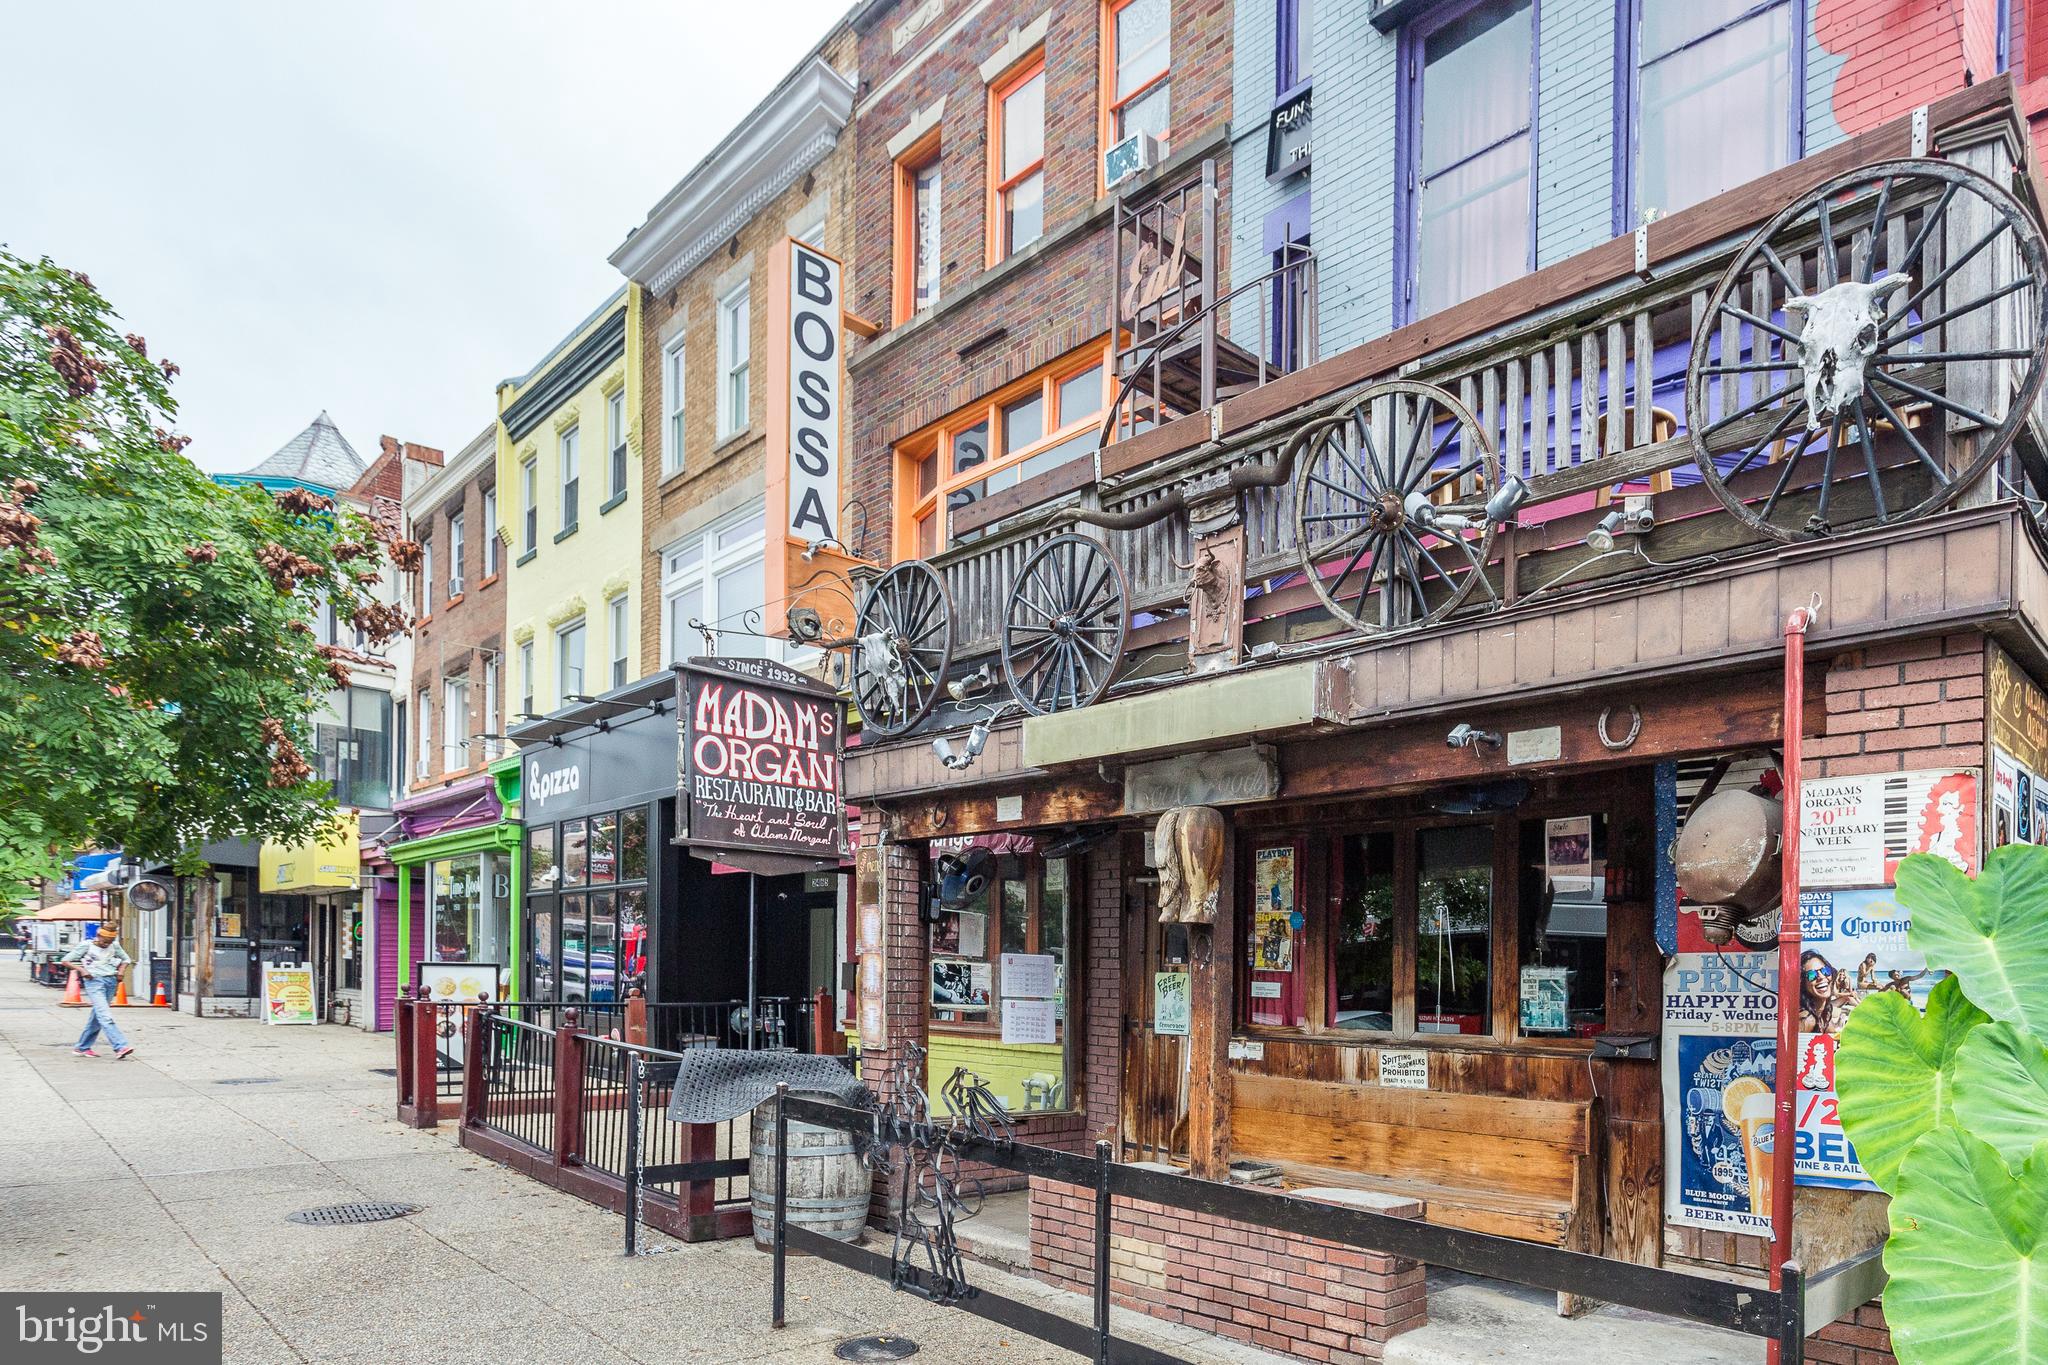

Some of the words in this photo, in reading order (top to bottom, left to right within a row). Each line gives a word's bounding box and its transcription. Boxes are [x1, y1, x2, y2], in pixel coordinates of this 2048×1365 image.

[1276, 101, 1305, 128] FUN
[793, 249, 835, 539] BOSSA
[728, 659, 763, 677] SINCE
[767, 667, 797, 684] 1992
[695, 681, 834, 750] MADAM'S
[693, 734, 835, 791] ORGAN
[530, 761, 580, 805] &pizza
[695, 775, 797, 809] RESTAURANT
[805, 790, 837, 815] BAR
[1805, 785, 1862, 799] MADAMS
[1805, 796, 1862, 808] ORGAN'S
[724, 804, 764, 824] Heart
[767, 812, 791, 826] and
[794, 813, 828, 830] Soul
[1810, 806, 1857, 826] 20TH
[733, 823, 746, 838] of
[751, 824, 788, 840] Adams
[1815, 836, 1852, 846] WEEK
[1257, 848, 1293, 859] PLAYBOY
[1812, 905, 1831, 915] US
[1862, 935, 1905, 943] SUMME
[1879, 944, 1905, 952] VIBE
[1701, 954, 1767, 970] HALF
[1157, 974, 1177, 993] FREE
[1162, 977, 1186, 999] BEER!
[1666, 995, 1739, 1009] HAPPY
[1665, 1009, 1713, 1022] Friday
[1711, 1022, 1760, 1033] 5-8PM
[1382, 1054, 1412, 1065] SPITTING
[1397, 1058, 1426, 1069] SIDEWALKS
[1382, 1067, 1426, 1077] PROHIBITED
[1693, 1078, 1722, 1088] TWIST
[1823, 1163, 1831, 1171] &
[1834, 1164, 1862, 1174] RAIL
[1685, 1189, 1707, 1199] BLUE
[1709, 1192, 1736, 1202] MOON
[1685, 1208, 1725, 1222] BEER
[1737, 1214, 1771, 1227] WIN
